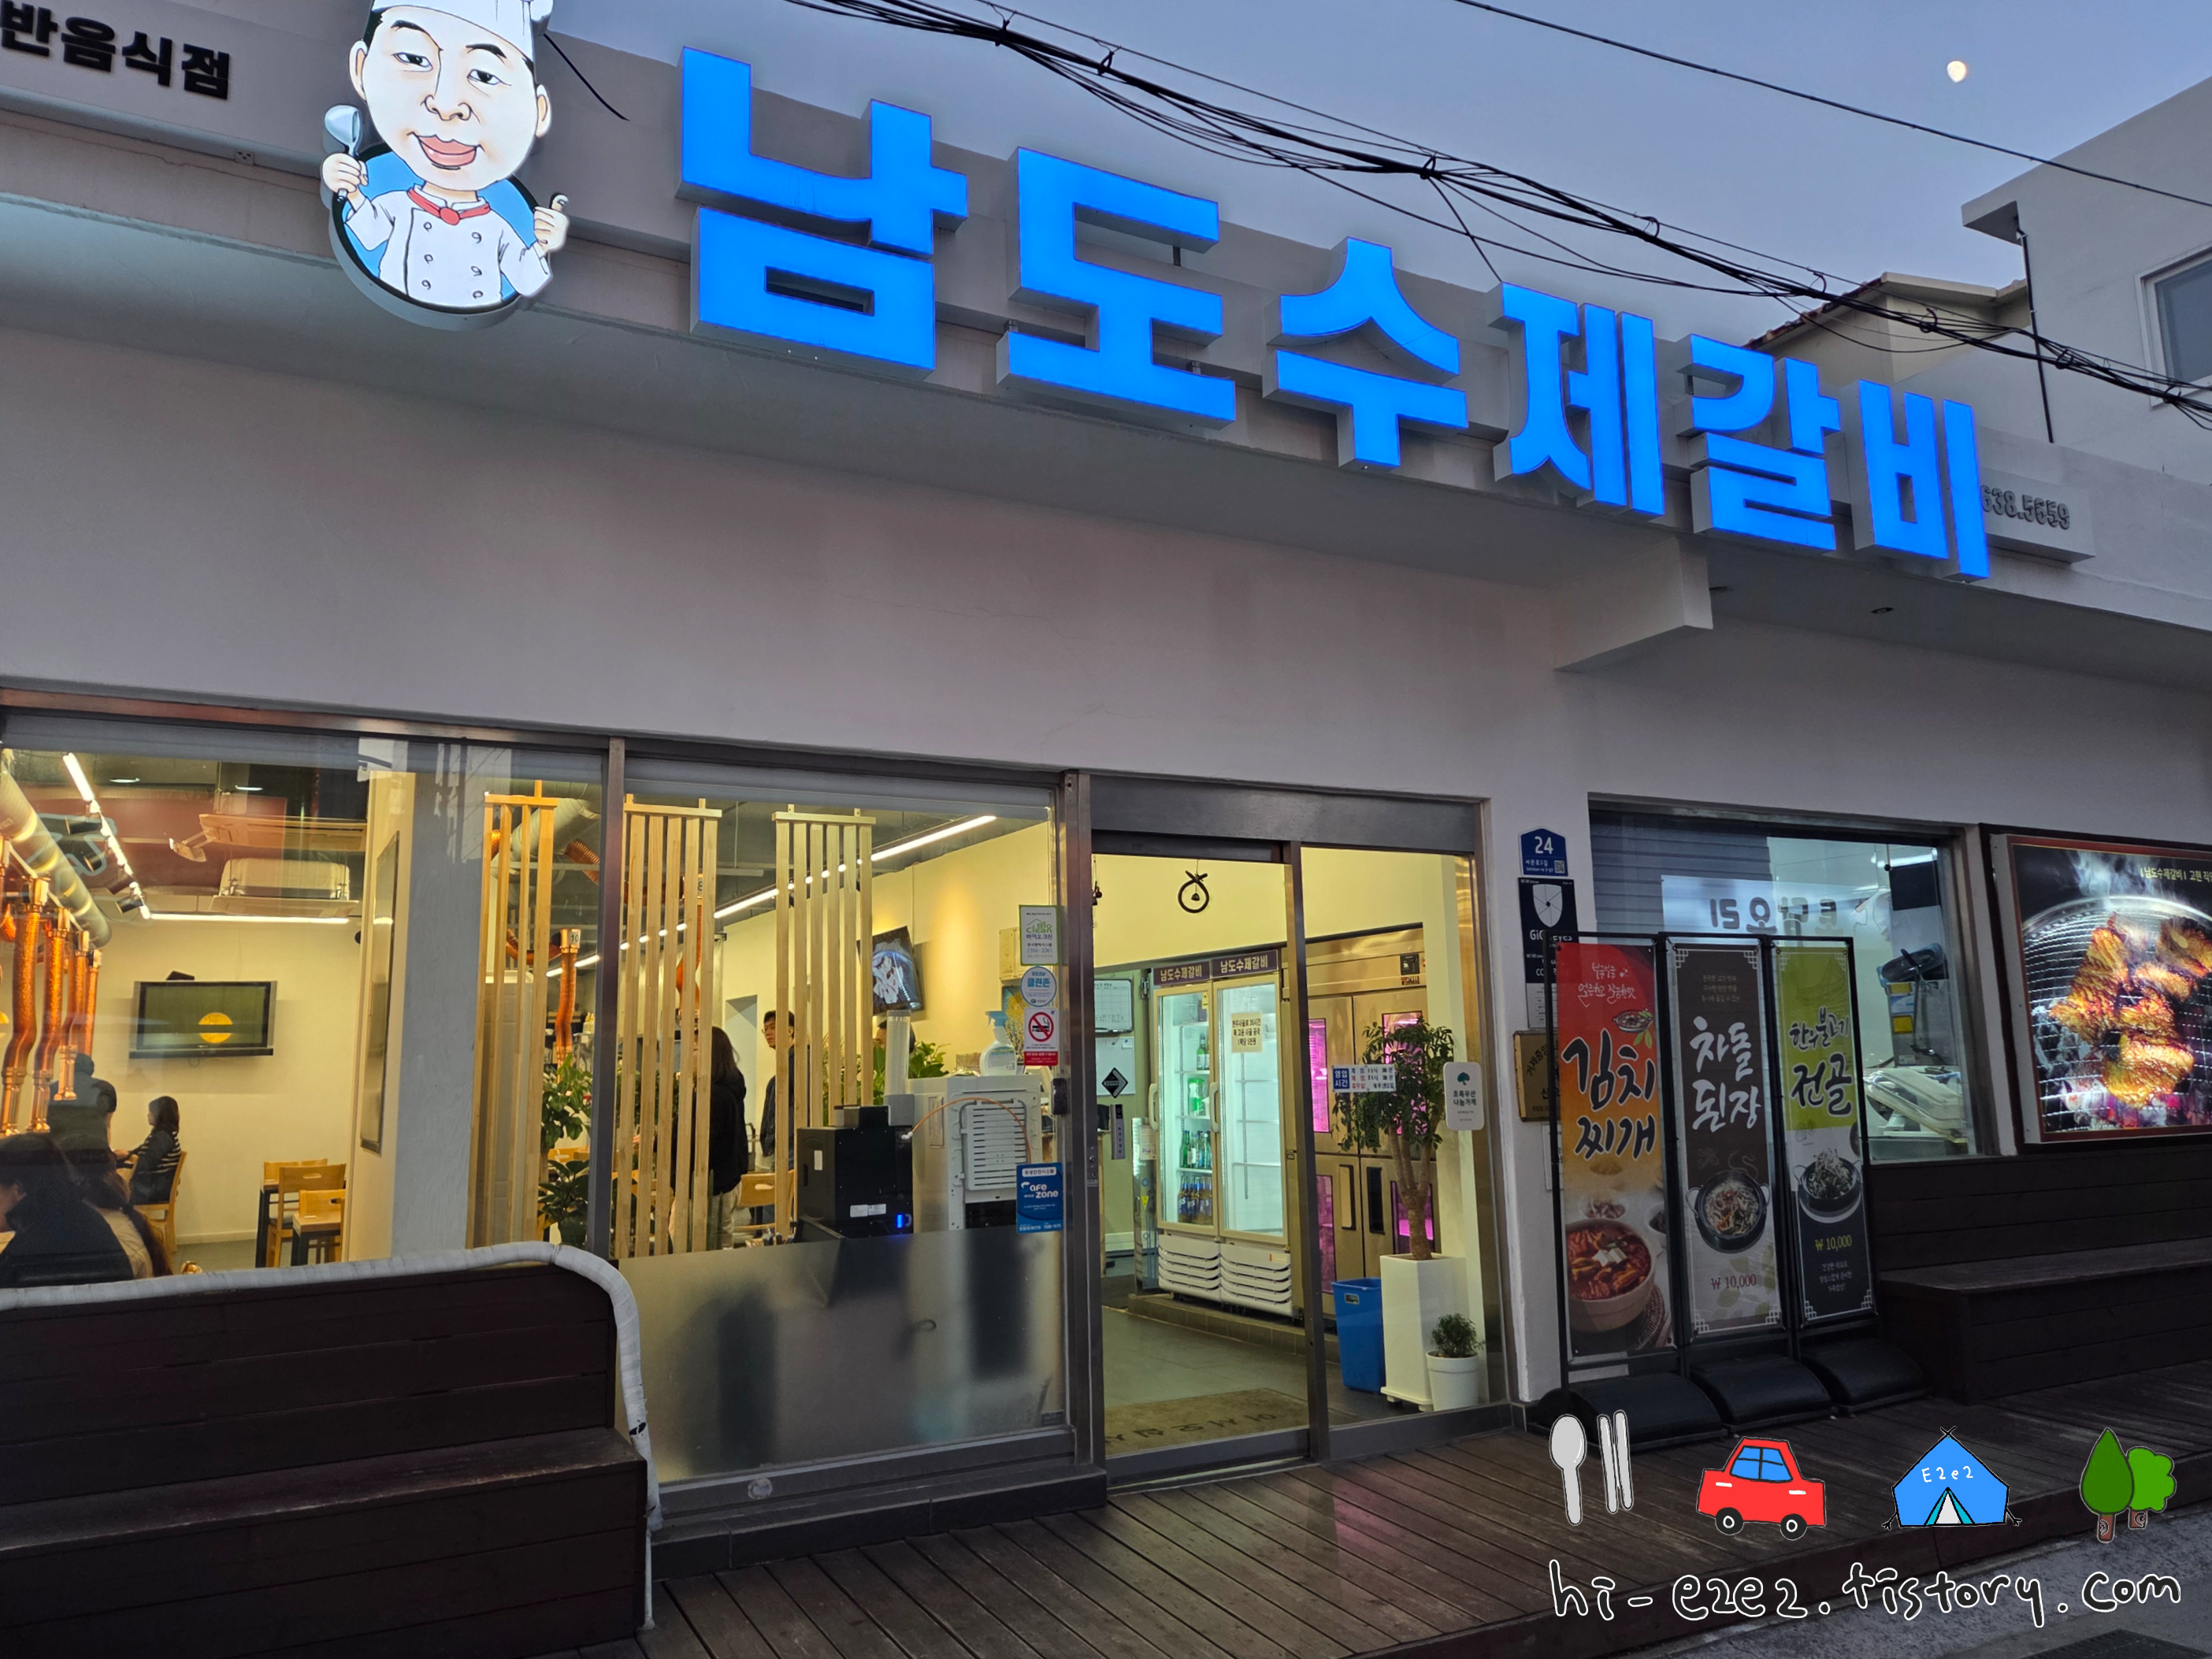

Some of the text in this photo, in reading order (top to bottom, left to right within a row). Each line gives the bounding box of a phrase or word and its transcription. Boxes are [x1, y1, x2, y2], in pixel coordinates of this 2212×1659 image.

[681, 45, 1991, 581] 남도수제갈비
[1535, 836, 1553, 855] 24
[1525, 859, 1548, 867] 서문로5길
[571, 934, 579, 943] 10
[1220, 955, 1268, 973] 남도수제갈비
[1160, 965, 1203, 982] 남도수제갈비
[1027, 978, 1050, 988] 클린존
[1788, 1006, 1850, 1053] 한우불고기
[1689, 1015, 1754, 1083] 차돌
[1335, 1070, 1348, 1078] 영업
[1560, 1026, 1655, 1112] 김치
[1790, 1052, 1854, 1115] 전골
[1691, 1078, 1761, 1133] 된장
[1574, 1113, 1655, 1160] 찌개
[1827, 1234, 1852, 1252] 10,000
[1725, 1274, 1757, 1289] 10,000
